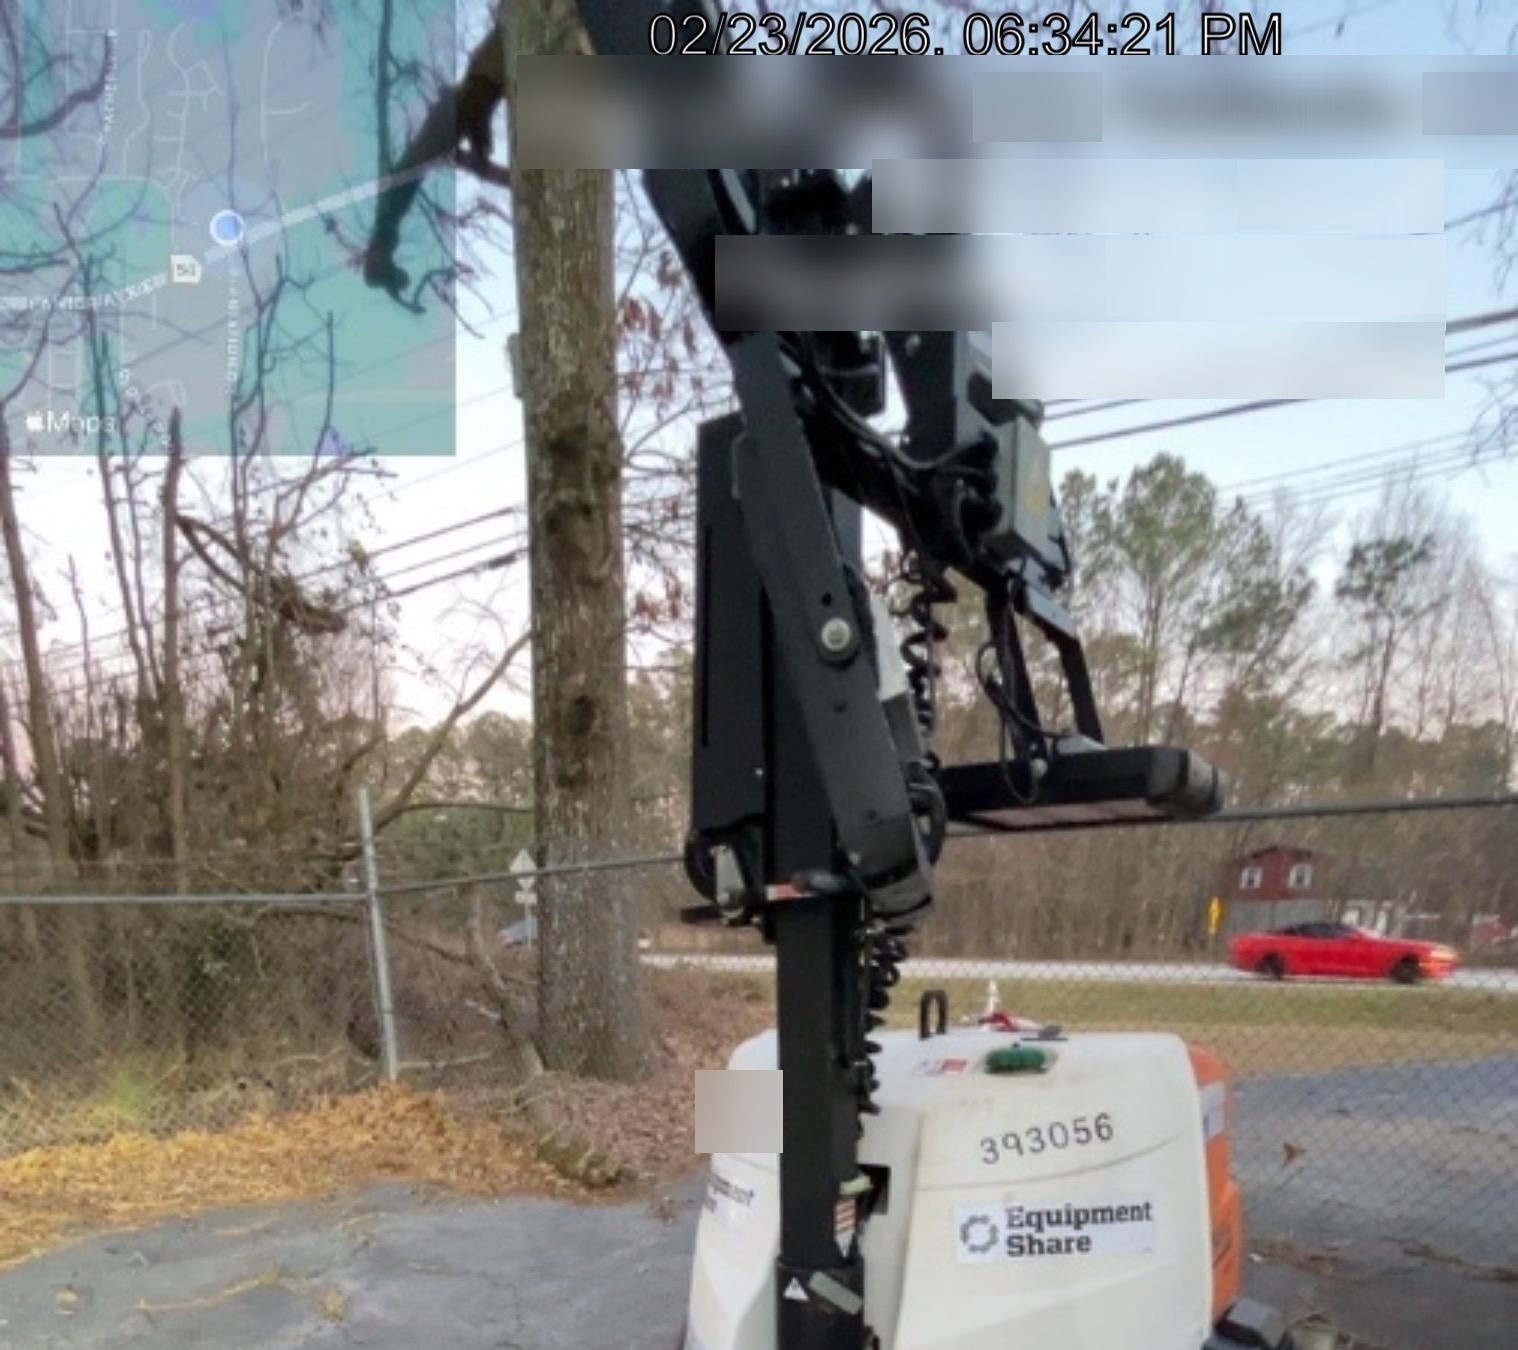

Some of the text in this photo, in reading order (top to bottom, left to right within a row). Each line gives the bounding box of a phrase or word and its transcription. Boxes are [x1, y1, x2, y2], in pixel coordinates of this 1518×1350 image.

[979, 1112, 1114, 1165] 393056
[1005, 1202, 1153, 1234] Equipment
[1007, 1234, 1092, 1257] Share
